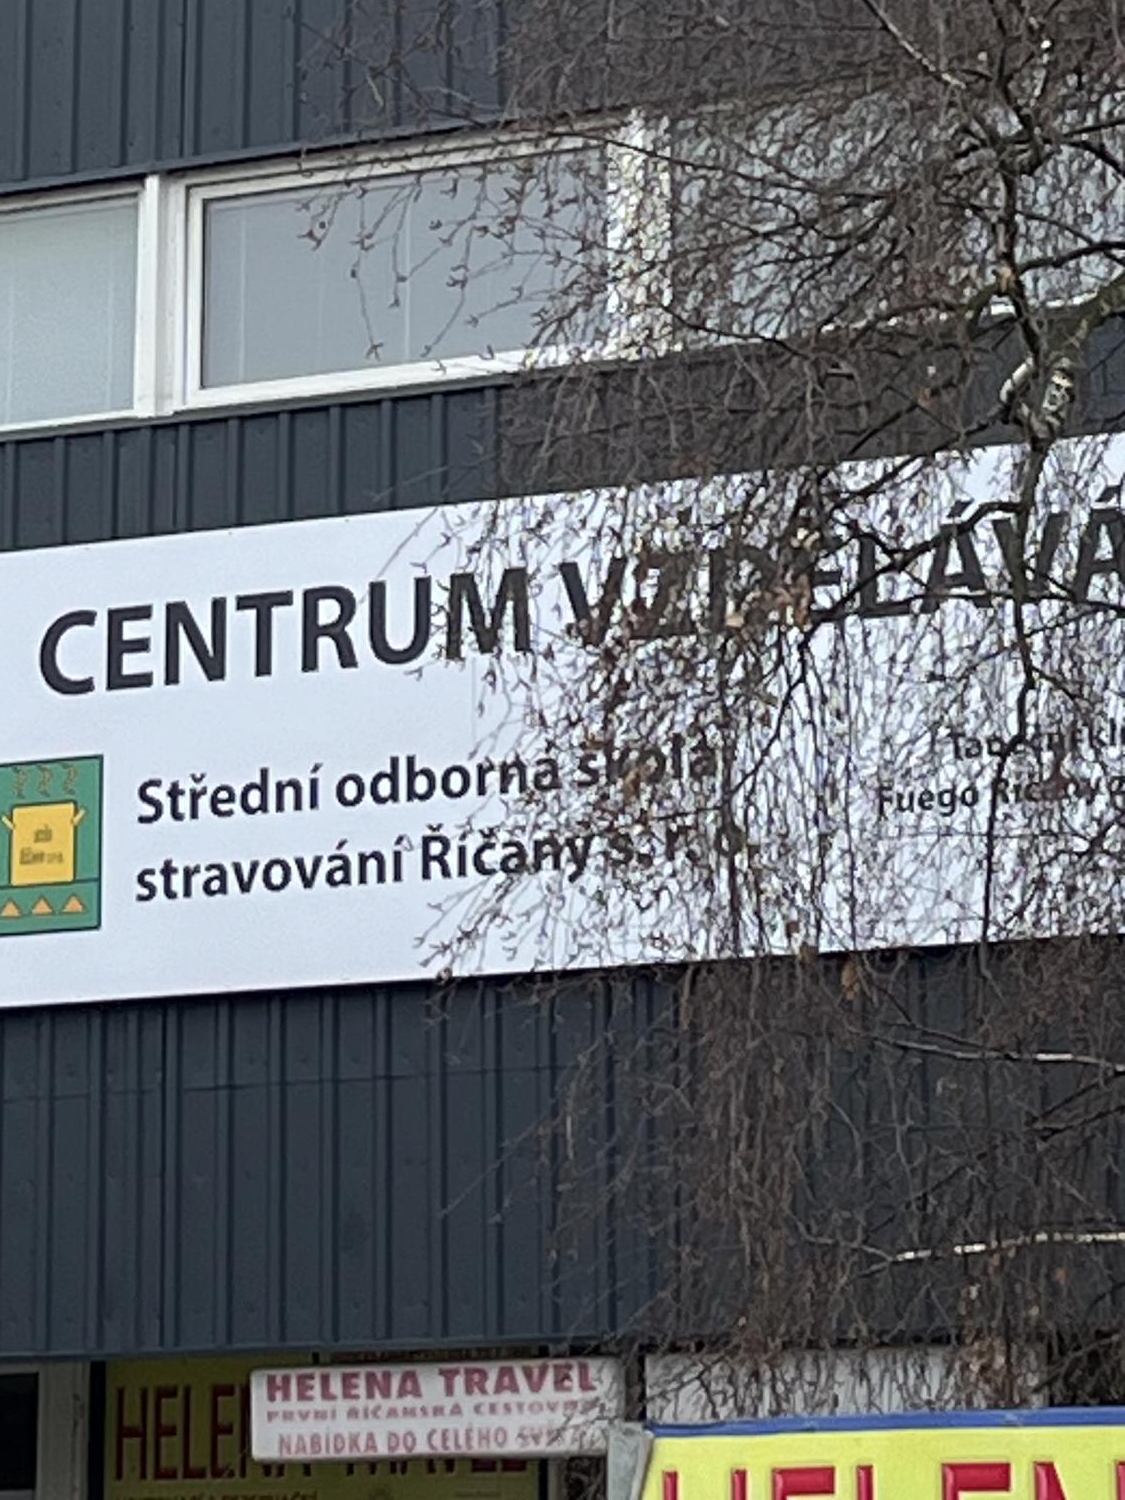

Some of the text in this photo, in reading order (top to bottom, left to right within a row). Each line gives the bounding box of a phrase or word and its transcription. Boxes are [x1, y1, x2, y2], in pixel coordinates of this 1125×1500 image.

[38, 566, 532, 696] CENTRUM
[137, 763, 323, 825] Střední
[336, 738, 562, 807] odborná
[877, 782, 979, 817] Fuego
[135, 835, 404, 902] stravování
[421, 823, 592, 883] Říčany
[267, 1360, 597, 1403] HELENA TRAVEL
[115, 1384, 312, 1481] HELE
[278, 1428, 379, 1456] NABÍDKA
[387, 1430, 417, 1454] DO
[426, 1423, 508, 1451] CELÉHO
